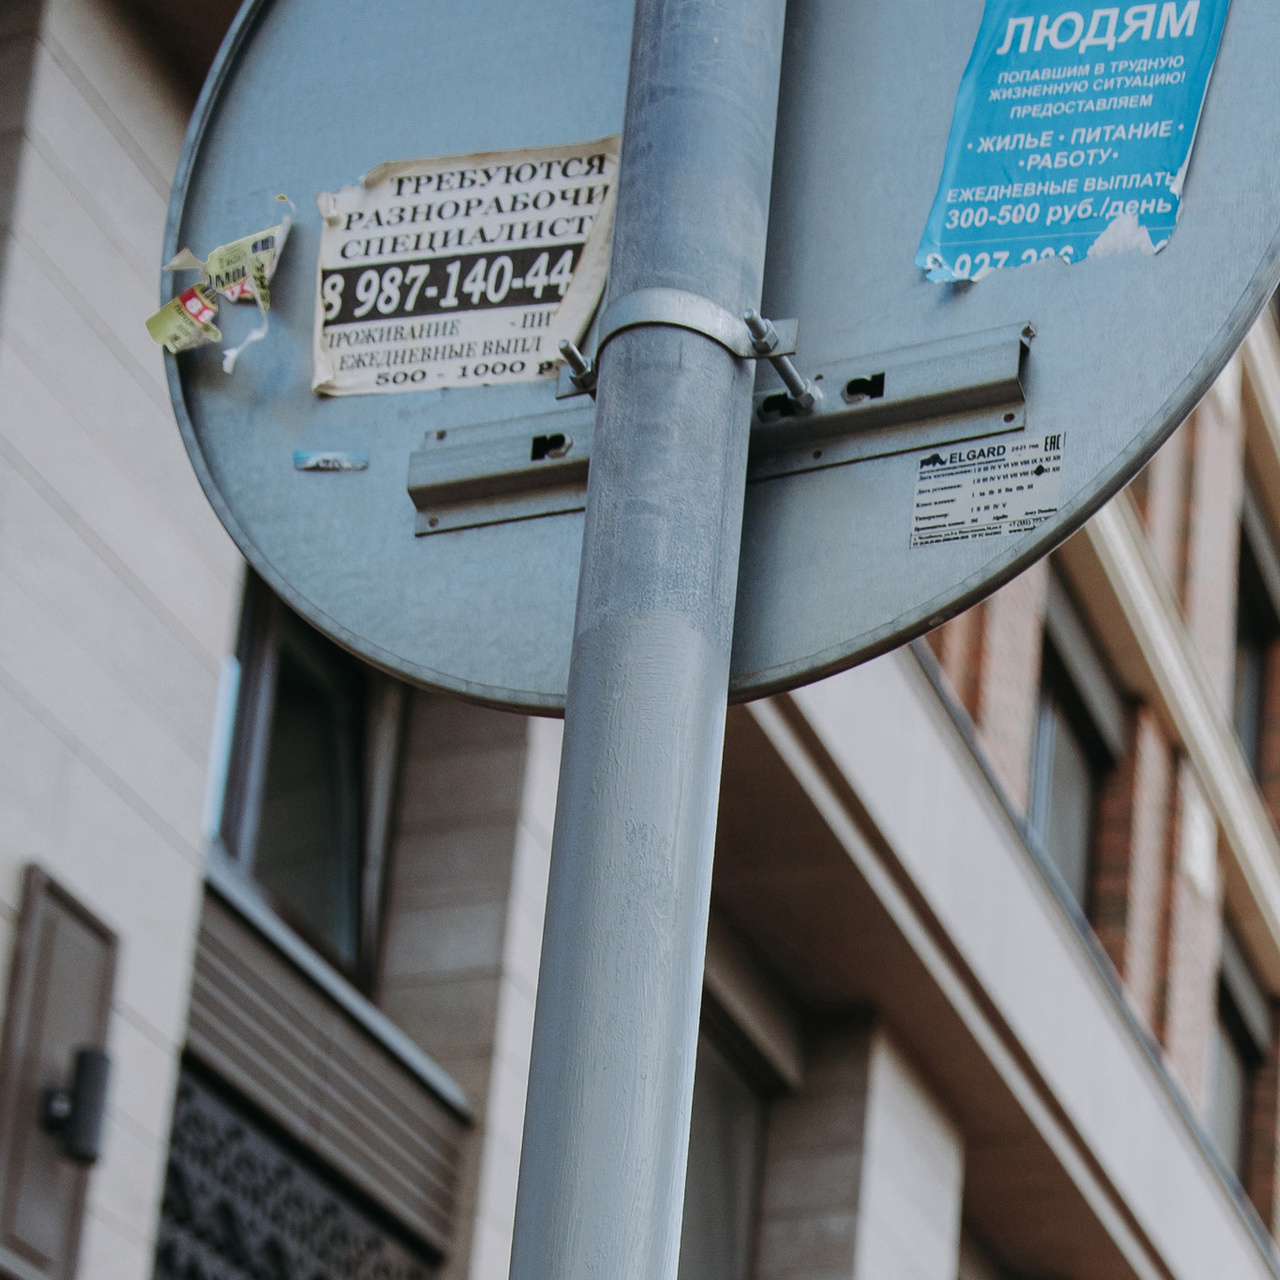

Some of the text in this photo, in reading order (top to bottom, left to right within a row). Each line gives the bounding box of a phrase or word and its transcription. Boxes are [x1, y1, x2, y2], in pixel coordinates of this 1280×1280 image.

[996, 1, 1200, 55] ЛЮДЯМ
[998, 55, 1185, 84] ПОПАВШИМ В ТРУДНУЮ
[988, 71, 1186, 101] ЖИЗНЕННУЮ СИТУАЦИЮ!
[1010, 94, 1153, 119] ПРЕДОСТАВЛЯЕМ
[976, 120, 1173, 153] ЖИЛЬЕ ПИТАНИЕ
[391, 153, 606, 196] ТРЕБУЮТСЯ
[947, 178, 1078, 204] ЕЖЕДНЕВНЫЕ
[945, 202, 1040, 229] 300-500
[322, 273, 345, 321] 8
[338, 341, 477, 372] ЕЖЕДНЕВНЫЕ
[375, 368, 427, 386] 500
[457, 360, 526, 379] 1000
[949, 445, 1006, 464] ELGARD
